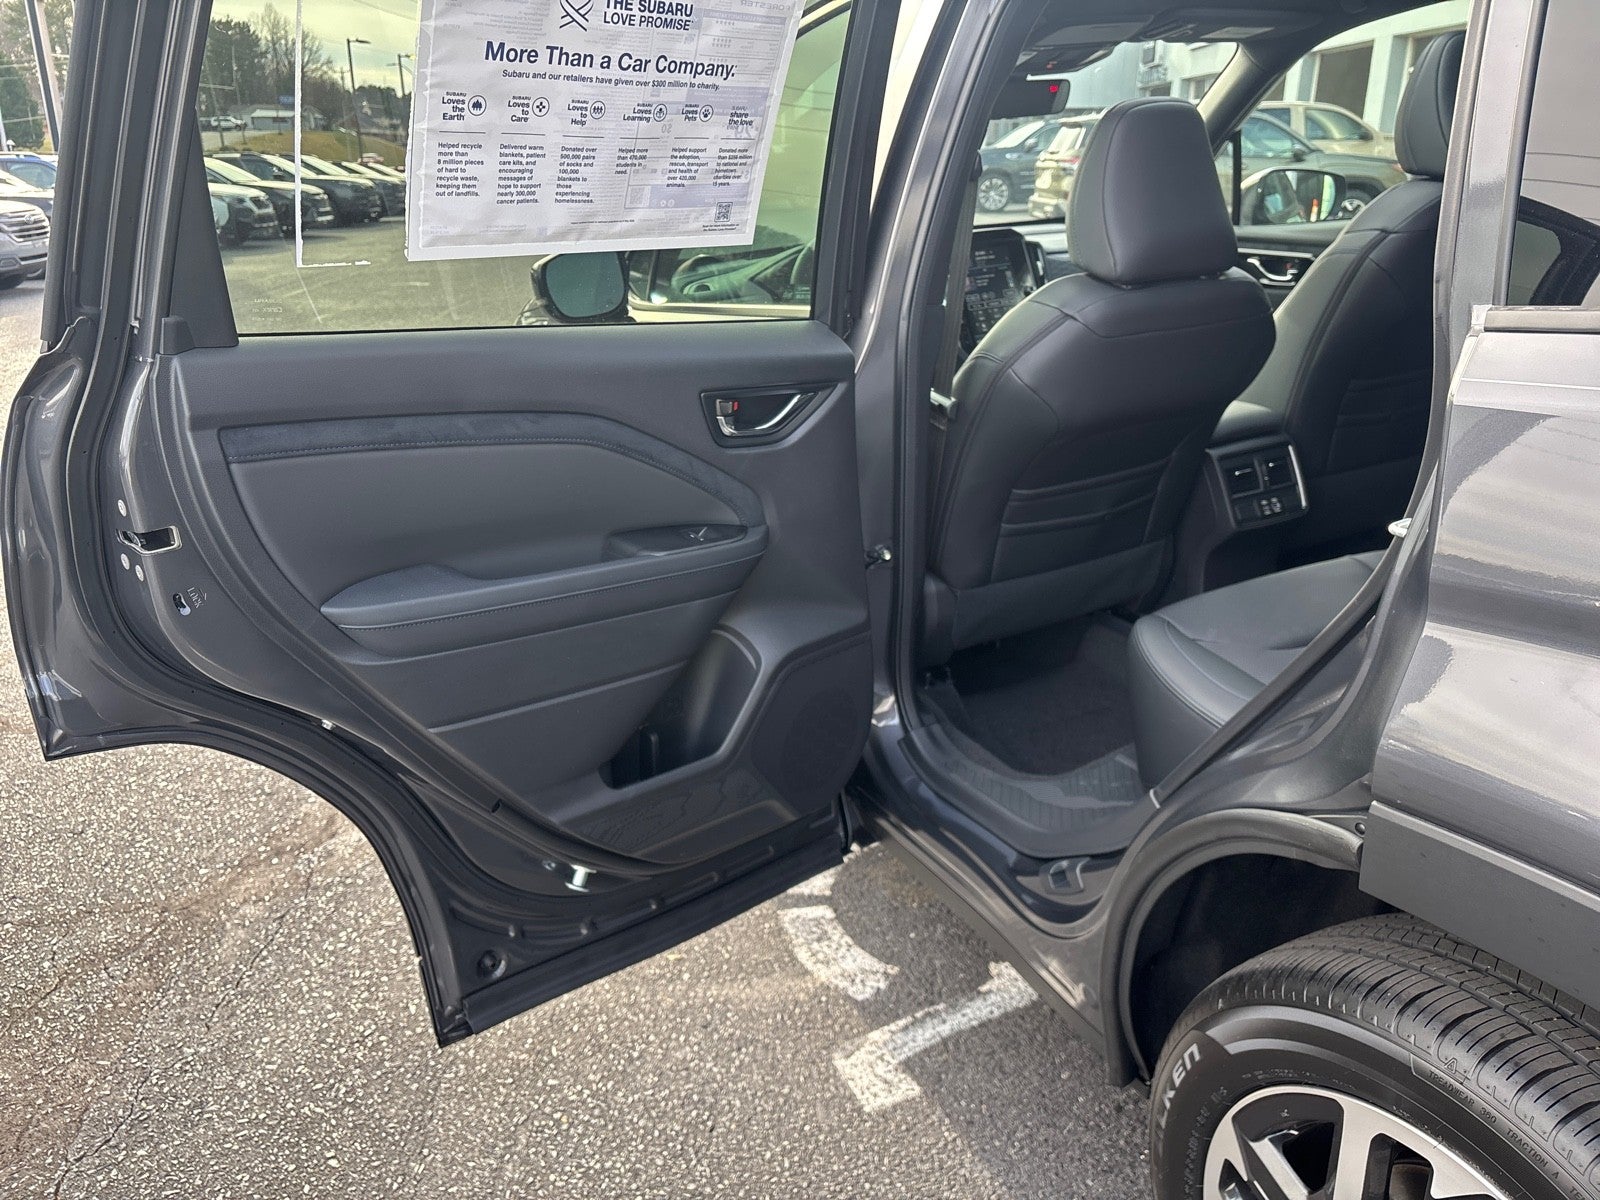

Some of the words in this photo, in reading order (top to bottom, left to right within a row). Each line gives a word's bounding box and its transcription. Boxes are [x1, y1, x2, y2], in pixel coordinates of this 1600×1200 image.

[605, 0, 634, 11] THE
[638, 0, 694, 17] SUBARU
[603, 12, 636, 27] LOVE
[484, 40, 539, 64] More
[546, 45, 595, 68] Than
[600, 54, 612, 70] a
[617, 52, 651, 73] Car
[655, 55, 736, 81] Company.
[502, 69, 530, 79] Subaru
[532, 72, 547, 80] and
[548, 73, 562, 81] our
[563, 74, 594, 83] retailers
[595, 76, 612, 85] have
[614, 78, 634, 88] given
[635, 80, 650, 88] over
[651, 79, 667, 88] $300
[667, 80, 688, 88] million
[689, 81, 696, 89] to
[697, 83, 720, 92] charity.
[441, 97, 466, 105] Loves
[508, 100, 530, 109] Loves
[452, 105, 465, 113] the
[567, 104, 589, 112] Loves
[632, 107, 652, 115] Loves
[442, 113, 465, 121] Earth
[510, 115, 529, 123] Care
[622, 114, 651, 124] Learning
[684, 114, 697, 122] Pets
[730, 111, 749, 119] share
[570, 118, 587, 127] Help
[728, 118, 740, 126] the
[740, 118, 754, 126] love
[438, 142, 460, 150] Helped
[187, 587, 202, 609] LOCK
[1429, 1070, 1475, 1106] TREADWEAR
[1506, 1128, 1549, 1167] TRACTION
[1552, 1171, 1560, 1179] A
